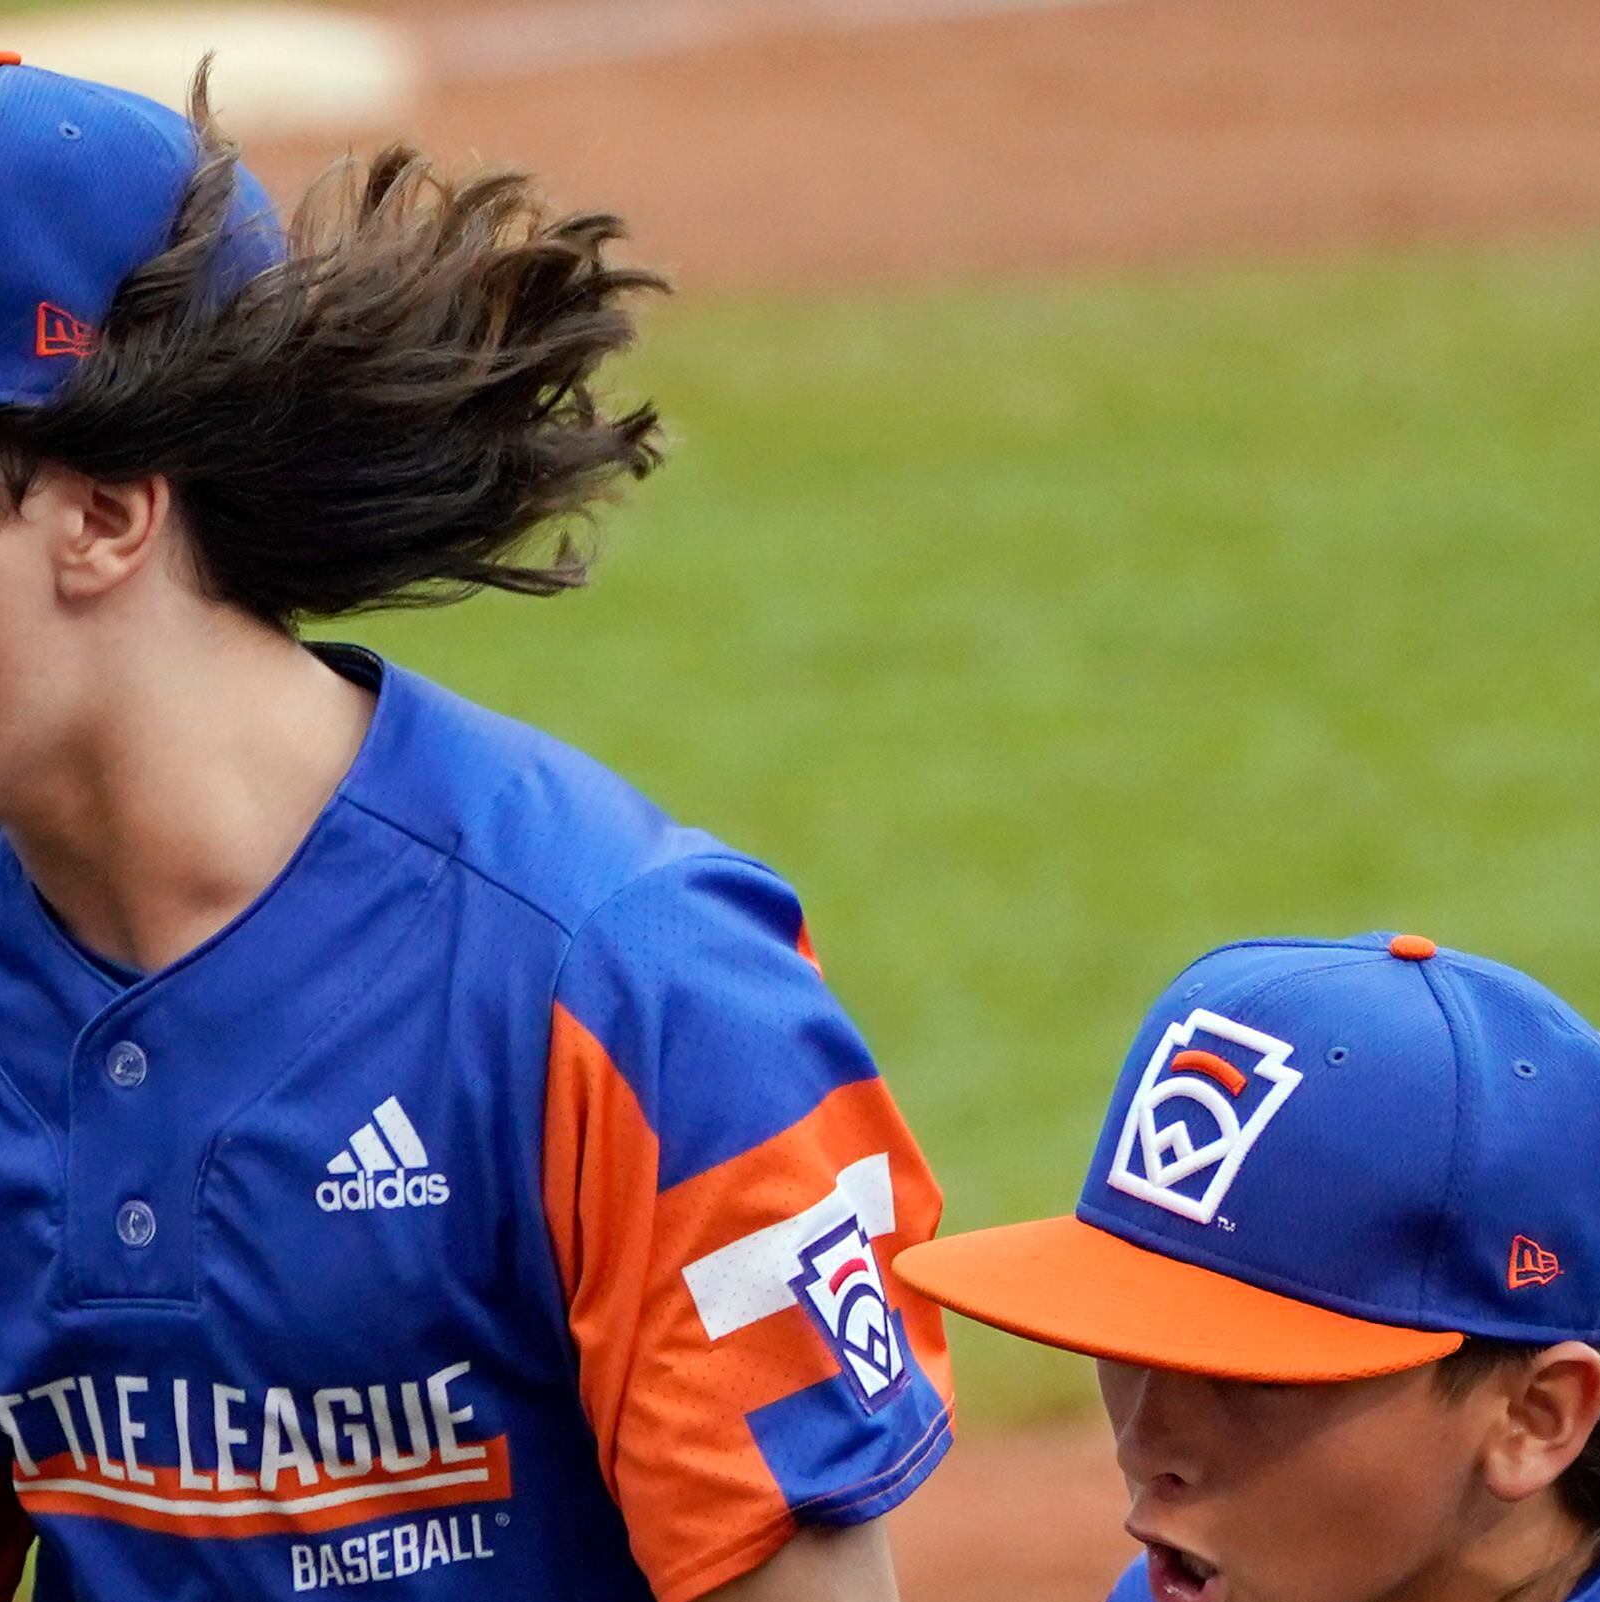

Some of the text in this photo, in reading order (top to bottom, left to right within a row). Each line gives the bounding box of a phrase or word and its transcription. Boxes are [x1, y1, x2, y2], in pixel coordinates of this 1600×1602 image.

[316, 1167, 450, 1212] adidas
[174, 1361, 487, 1492] LEAGUE
[292, 1514, 495, 1591] BASEBALL
